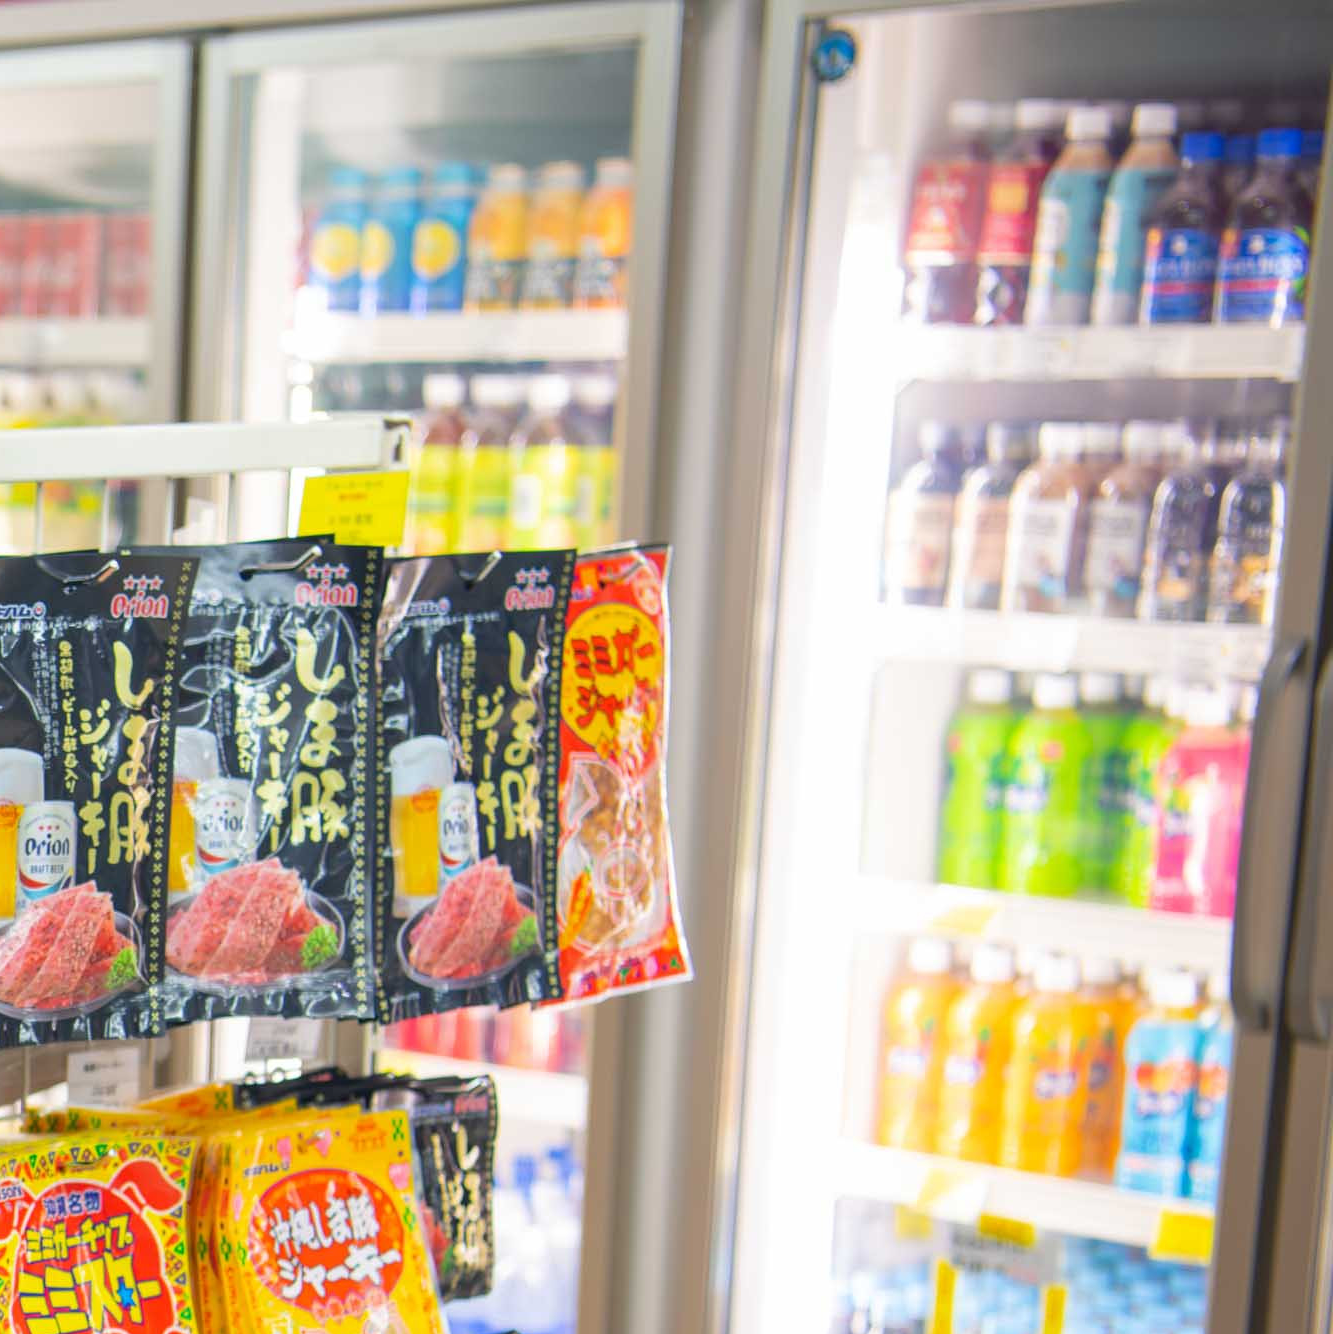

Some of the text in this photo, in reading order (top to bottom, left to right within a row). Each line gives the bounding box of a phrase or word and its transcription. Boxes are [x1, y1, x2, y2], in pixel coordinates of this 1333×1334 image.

[110, 588, 169, 619] Orion
[289, 626, 352, 848] しま豚
[78, 698, 111, 875] ジャーキー
[24, 832, 71, 858] Orion
[267, 1193, 381, 1256] 沖縄しま豚
[278, 1242, 403, 1300] ジャーキー
